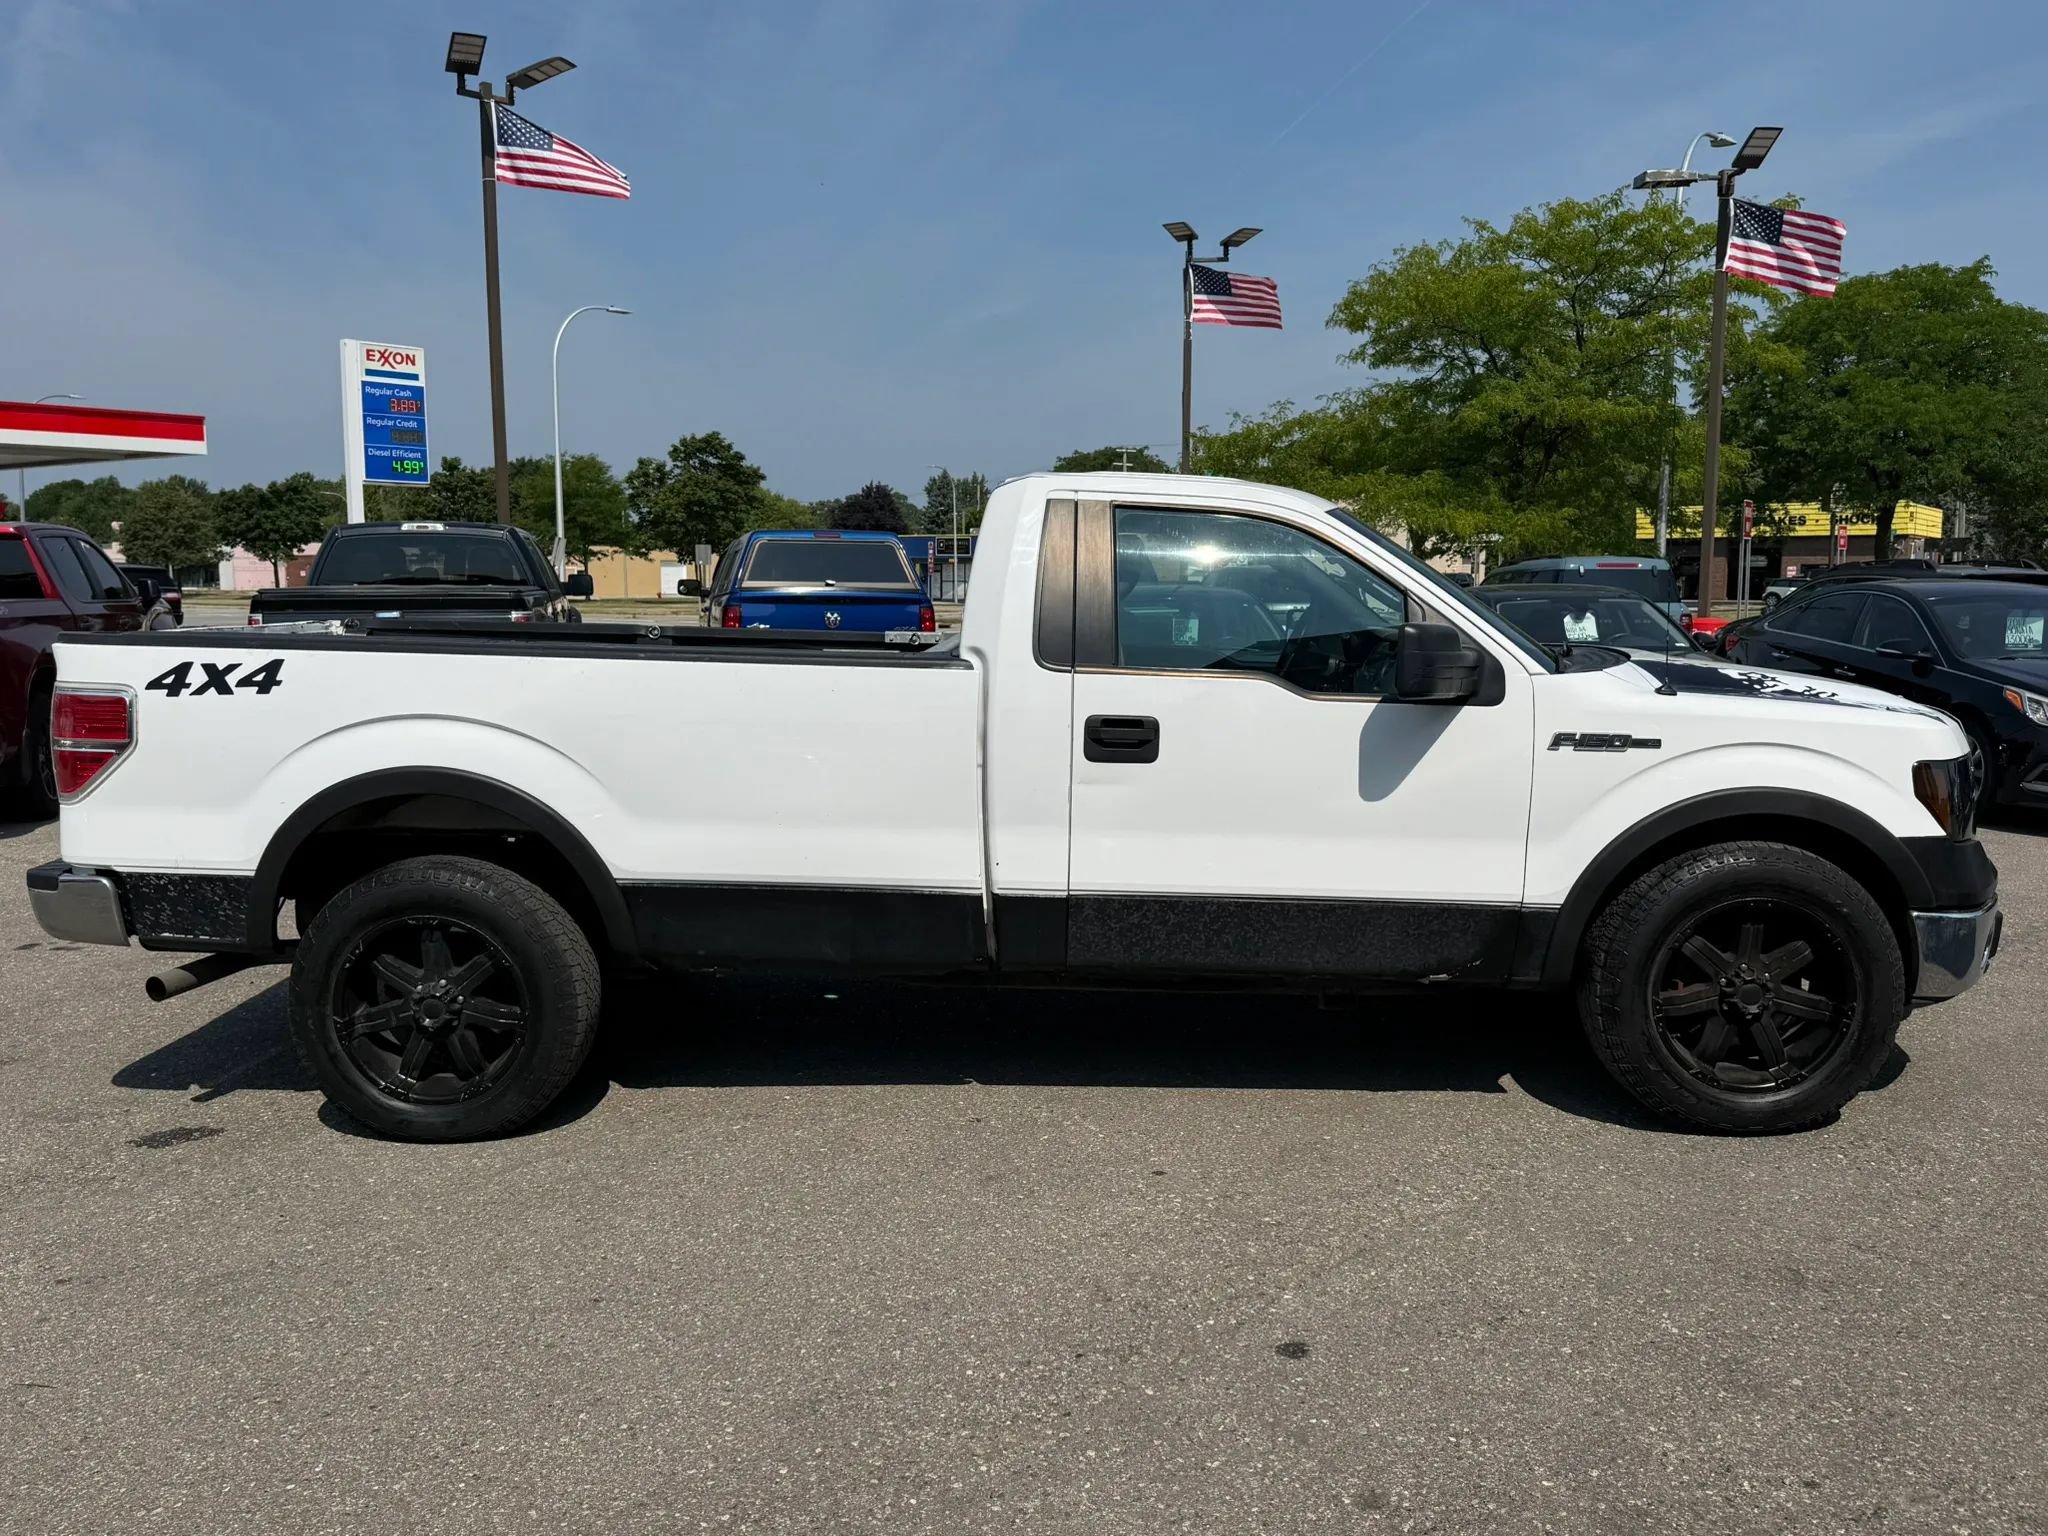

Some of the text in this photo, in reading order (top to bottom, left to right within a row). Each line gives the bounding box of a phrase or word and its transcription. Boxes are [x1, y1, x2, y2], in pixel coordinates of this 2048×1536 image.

[366, 349, 416, 369] EXXON
[365, 385, 412, 397] Regular Cash
[366, 416, 417, 428] Regular Credit
[368, 447, 421, 459] Diesel Efficient
[144, 658, 285, 697] 4X4
